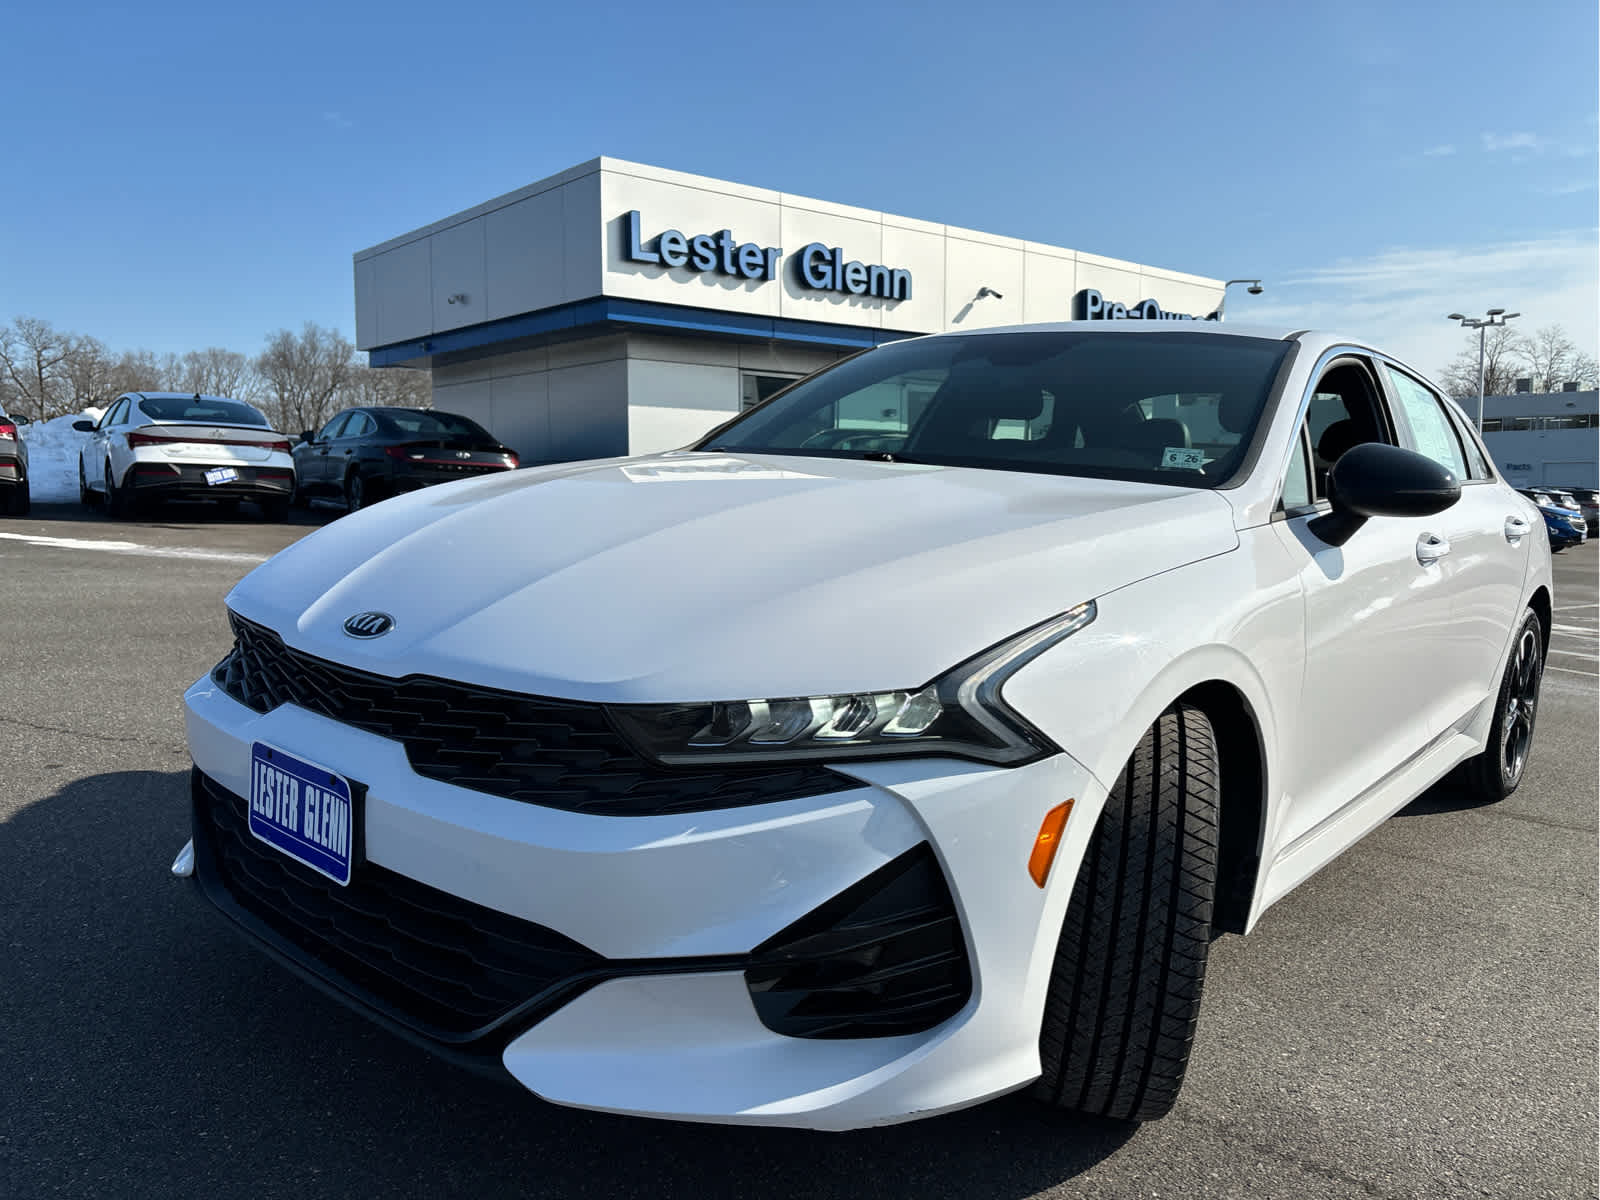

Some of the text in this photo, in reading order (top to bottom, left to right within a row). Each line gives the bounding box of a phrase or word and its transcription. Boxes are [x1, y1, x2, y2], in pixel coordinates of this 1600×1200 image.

[628, 210, 912, 300] Lester Glenn
[1169, 453, 1199, 463] 6 26
[346, 613, 385, 634] KIA
[253, 761, 348, 858] LESTER GLENN
